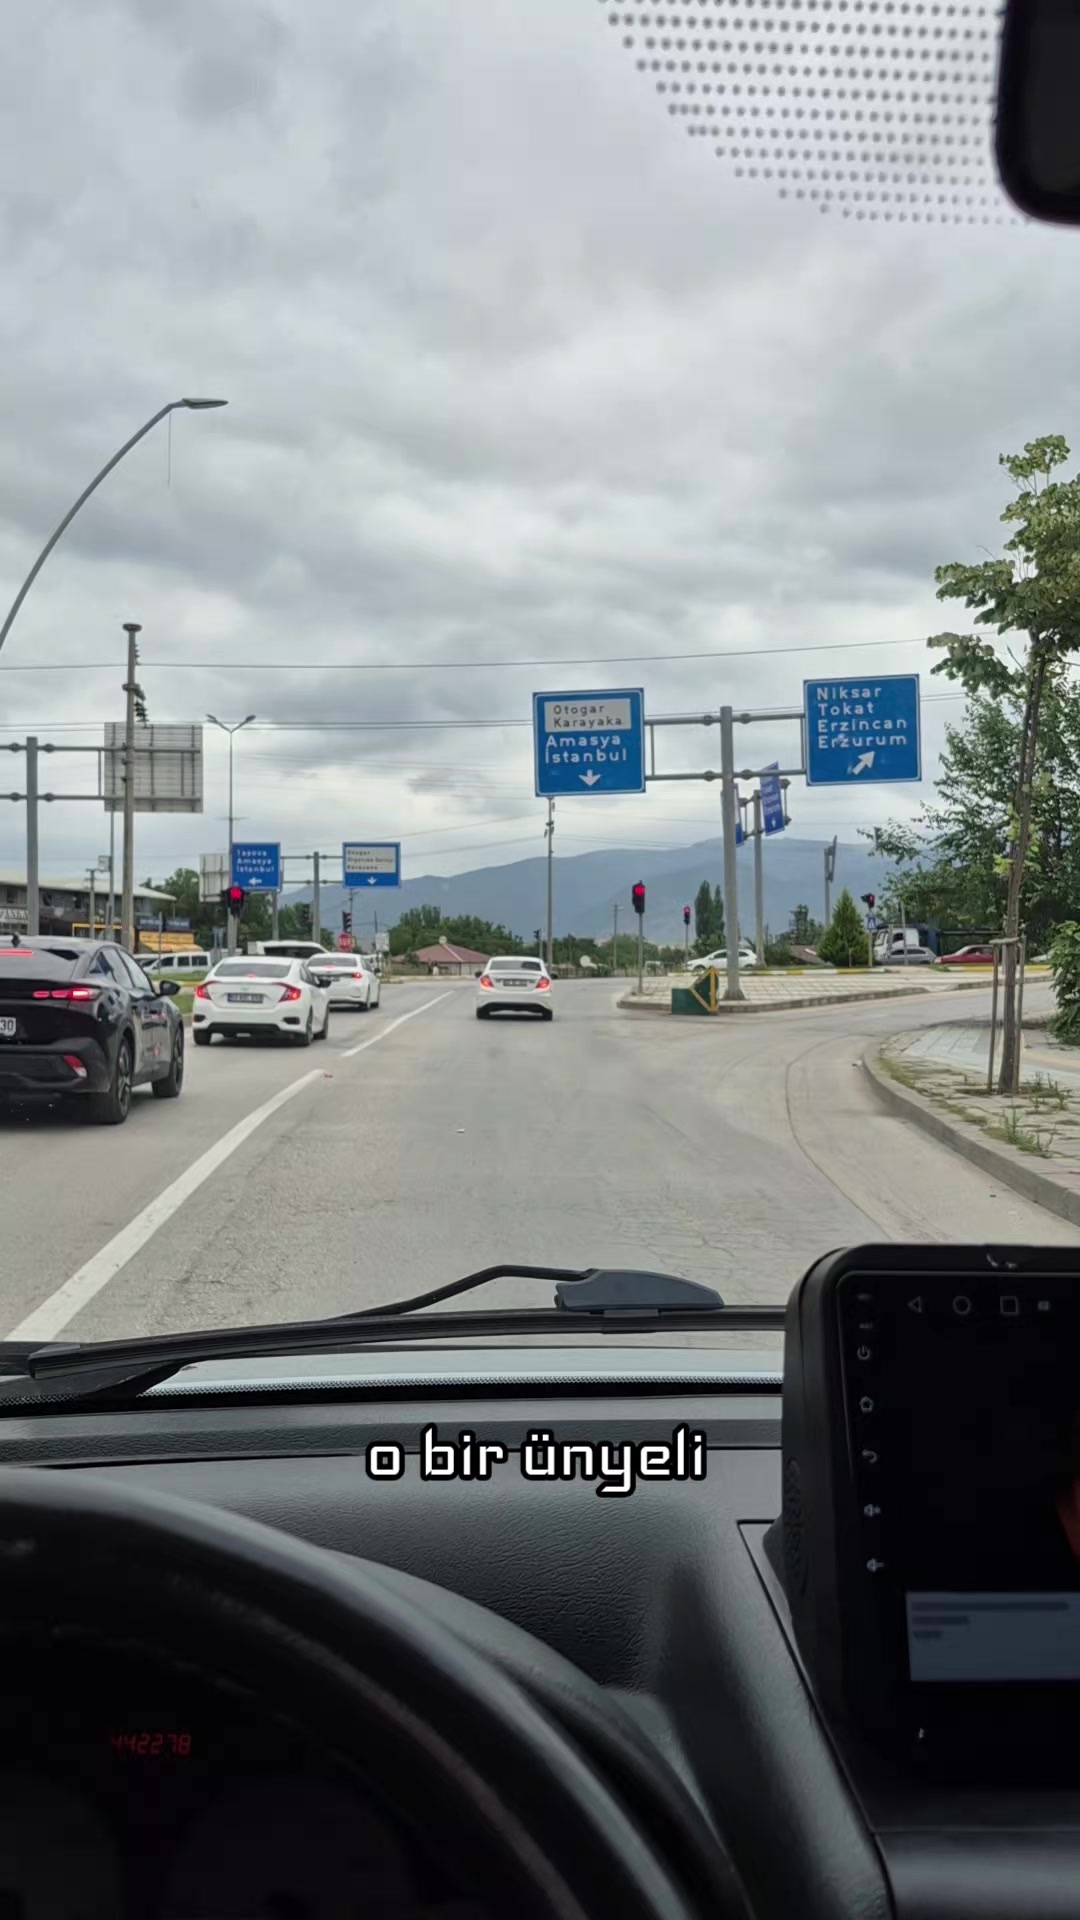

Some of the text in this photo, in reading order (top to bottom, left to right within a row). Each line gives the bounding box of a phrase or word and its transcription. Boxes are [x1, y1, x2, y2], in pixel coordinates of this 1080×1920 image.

[817, 686, 882, 700] Niksar
[553, 704, 605, 716] Otogar
[818, 701, 875, 716] Tokat
[553, 716, 622, 728] Karayaka
[818, 718, 907, 733] Erzincan
[546, 734, 621, 749] Amasya
[818, 734, 907, 749] Erzurum
[112, 1733, 191, 1754] 442278
